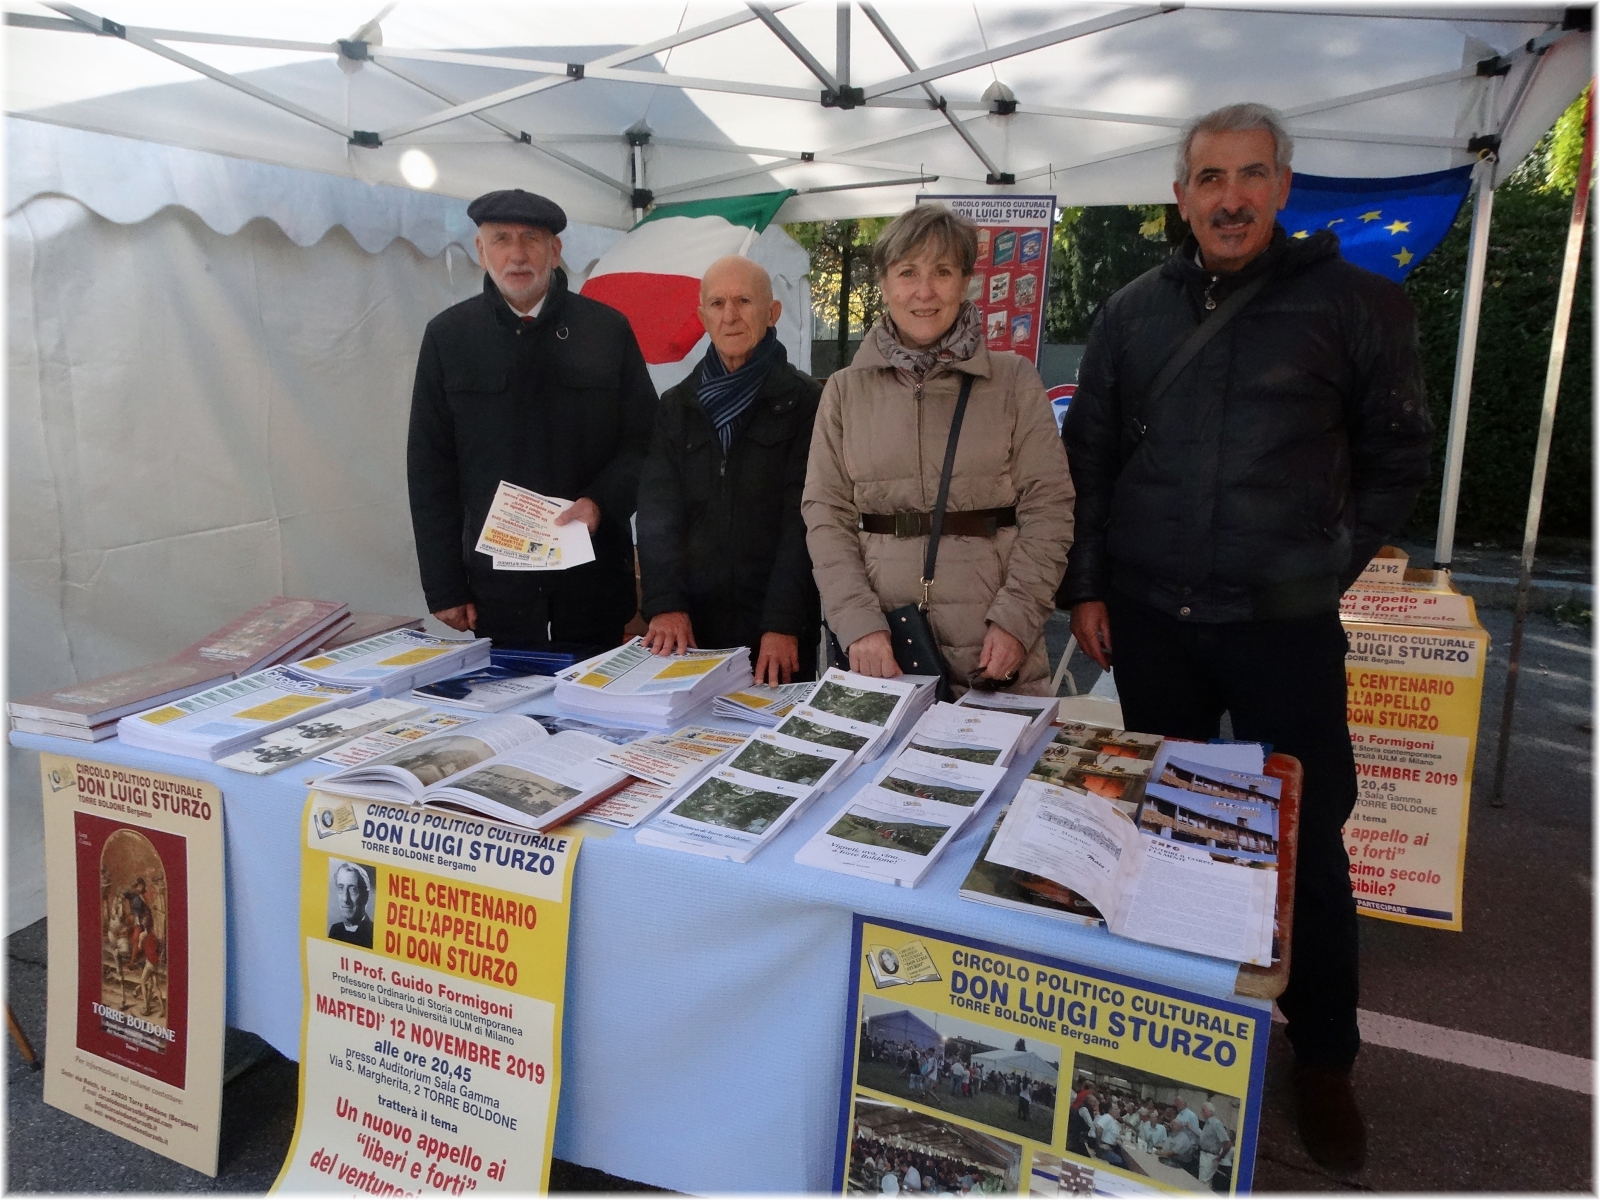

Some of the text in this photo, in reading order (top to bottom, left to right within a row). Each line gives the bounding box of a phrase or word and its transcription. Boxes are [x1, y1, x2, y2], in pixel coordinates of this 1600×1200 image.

[976, 209, 1002, 218] LUIGI
[1006, 209, 1046, 218] STURZO
[1387, 565, 1398, 573] 24
[1363, 595, 1417, 603] appello
[1423, 597, 1437, 605] ai
[1347, 641, 1469, 663] LUIGI STURZO
[1357, 632, 1407, 643] POLITICO
[1411, 636, 1475, 649] CULTURALE
[1372, 657, 1405, 665] Bergamo
[1360, 673, 1454, 696] CENTENARIO
[1347, 690, 1430, 712] L'APPELLO
[1347, 708, 1439, 731] DON STURZO
[1360, 745, 1380, 753] Storia
[1383, 748, 1442, 759] contemporanea
[1369, 735, 1434, 750] Formigoni
[76, 763, 203, 799] CIRCOLO POLITICO CULTURALE
[1355, 763, 1458, 786] OVEMBRE 2019
[1361, 780, 1396, 792] 20,45
[78, 776, 211, 820] DON LUIGI STURZO
[78, 795, 152, 818] TORRE BOLDONE Bergamo
[1356, 799, 1437, 815] TORRE BOLDONE
[1365, 791, 1384, 800] Sala
[1387, 794, 1421, 804] Gamma
[366, 803, 567, 853] CIRCOLO POLITICO CULTURALE
[1363, 814, 1387, 823] tema
[362, 820, 555, 875] DON LUIGI STURZO
[1351, 827, 1409, 843] appello
[1413, 833, 1429, 846] ai
[361, 840, 477, 873] TORRE BOLDONE Bergamo
[1349, 845, 1358, 856] e
[1351, 879, 1396, 896] sibile?
[1390, 870, 1441, 884] secolo
[388, 873, 537, 930] NEL CENTENARIO
[1357, 900, 1407, 913] PARTECIPARE
[385, 930, 518, 987] DI DON STURZO
[340, 957, 513, 1019] Il Prof. Guido Formigoni
[952, 950, 1250, 1041] CIRCOLO POLITICO CULTURALE
[332, 972, 523, 1036] Professore Ordinario di Storia contemporanea
[340, 985, 515, 1046] presso la Libera Università IULM di Milano
[92, 1002, 125, 1024] TORRE
[126, 1015, 176, 1043] BOLDONE
[949, 994, 1119, 1051] TORRE BOLDONE Bergamo
[950, 971, 1238, 1068] DON LUIGI STURZO
[374, 1040, 472, 1082] alle ore 20,45
[390, 1017, 406, 1040] 12
[410, 1025, 501, 1070] NOVEMBRE
[506, 1054, 545, 1085] 2019
[345, 1047, 500, 1109] presso Auditorium Sala Gamma
[329, 1054, 518, 1131] Via S. Margherita, 2 TORRE BOLDONE
[377, 1094, 458, 1134] tratterà il tema
[336, 1096, 507, 1182] Un nuovo appello ai
[309, 1147, 338, 1175] del
[410, 1162, 422, 1179] e
